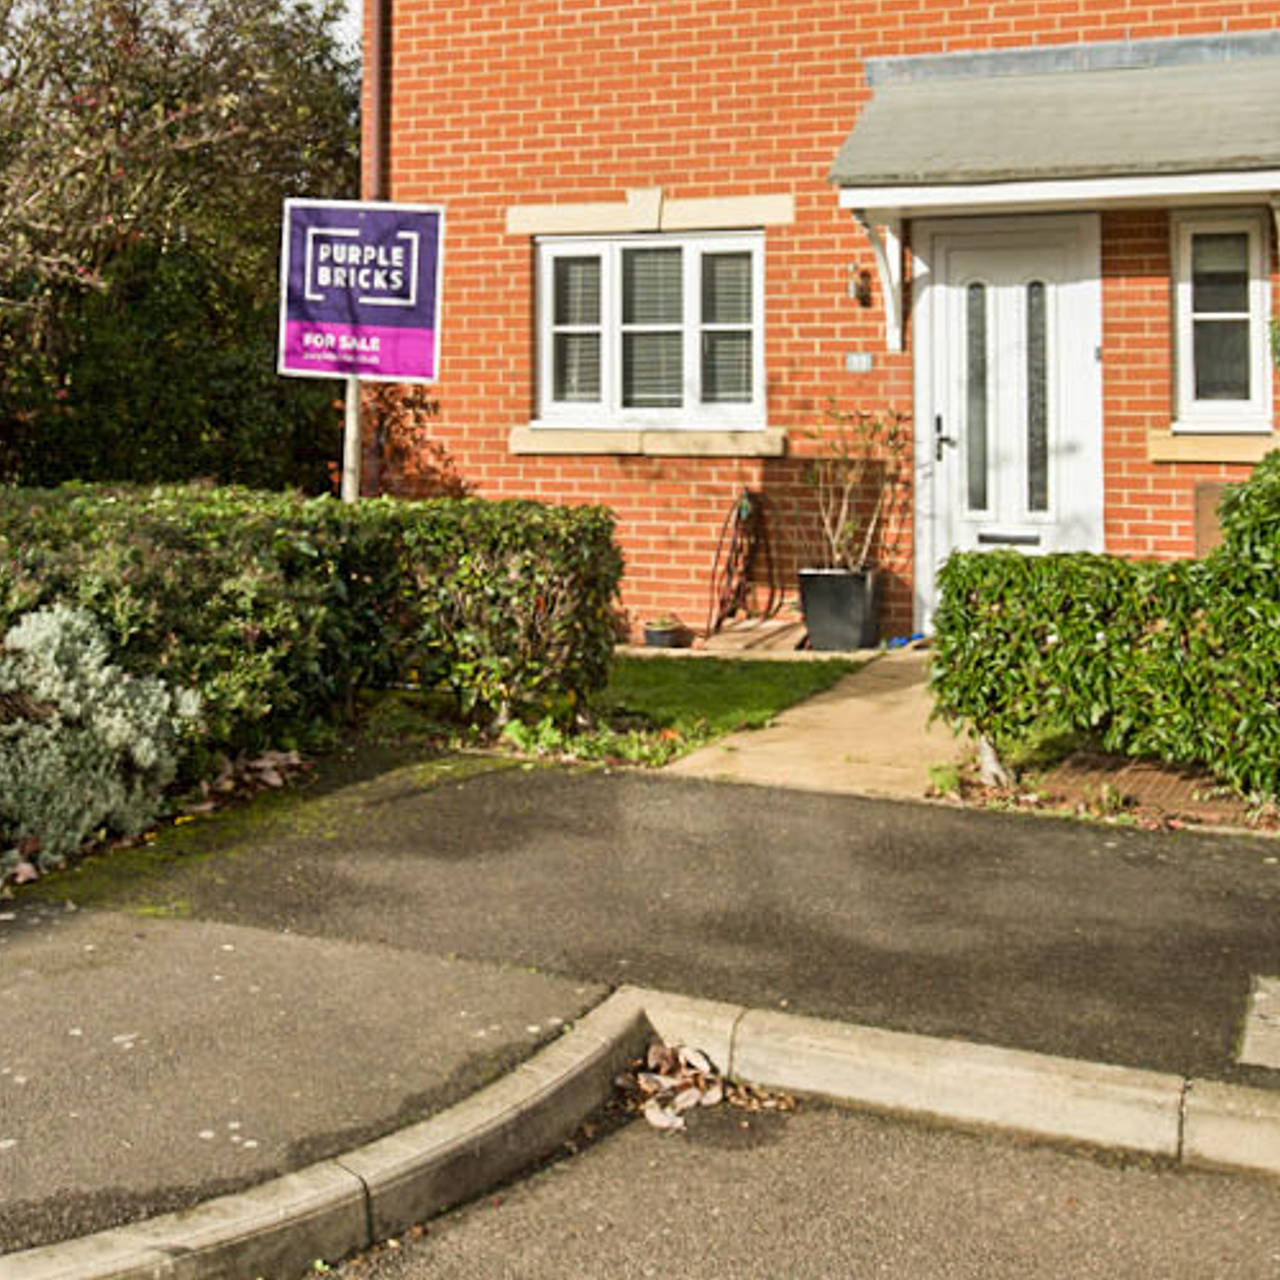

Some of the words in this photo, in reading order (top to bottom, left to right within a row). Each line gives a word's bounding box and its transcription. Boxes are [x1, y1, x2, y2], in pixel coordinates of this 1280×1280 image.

[319, 243, 404, 267] PURPLE
[317, 265, 404, 290] BRICKS
[303, 332, 336, 349] FOR
[338, 335, 380, 352] SALE
